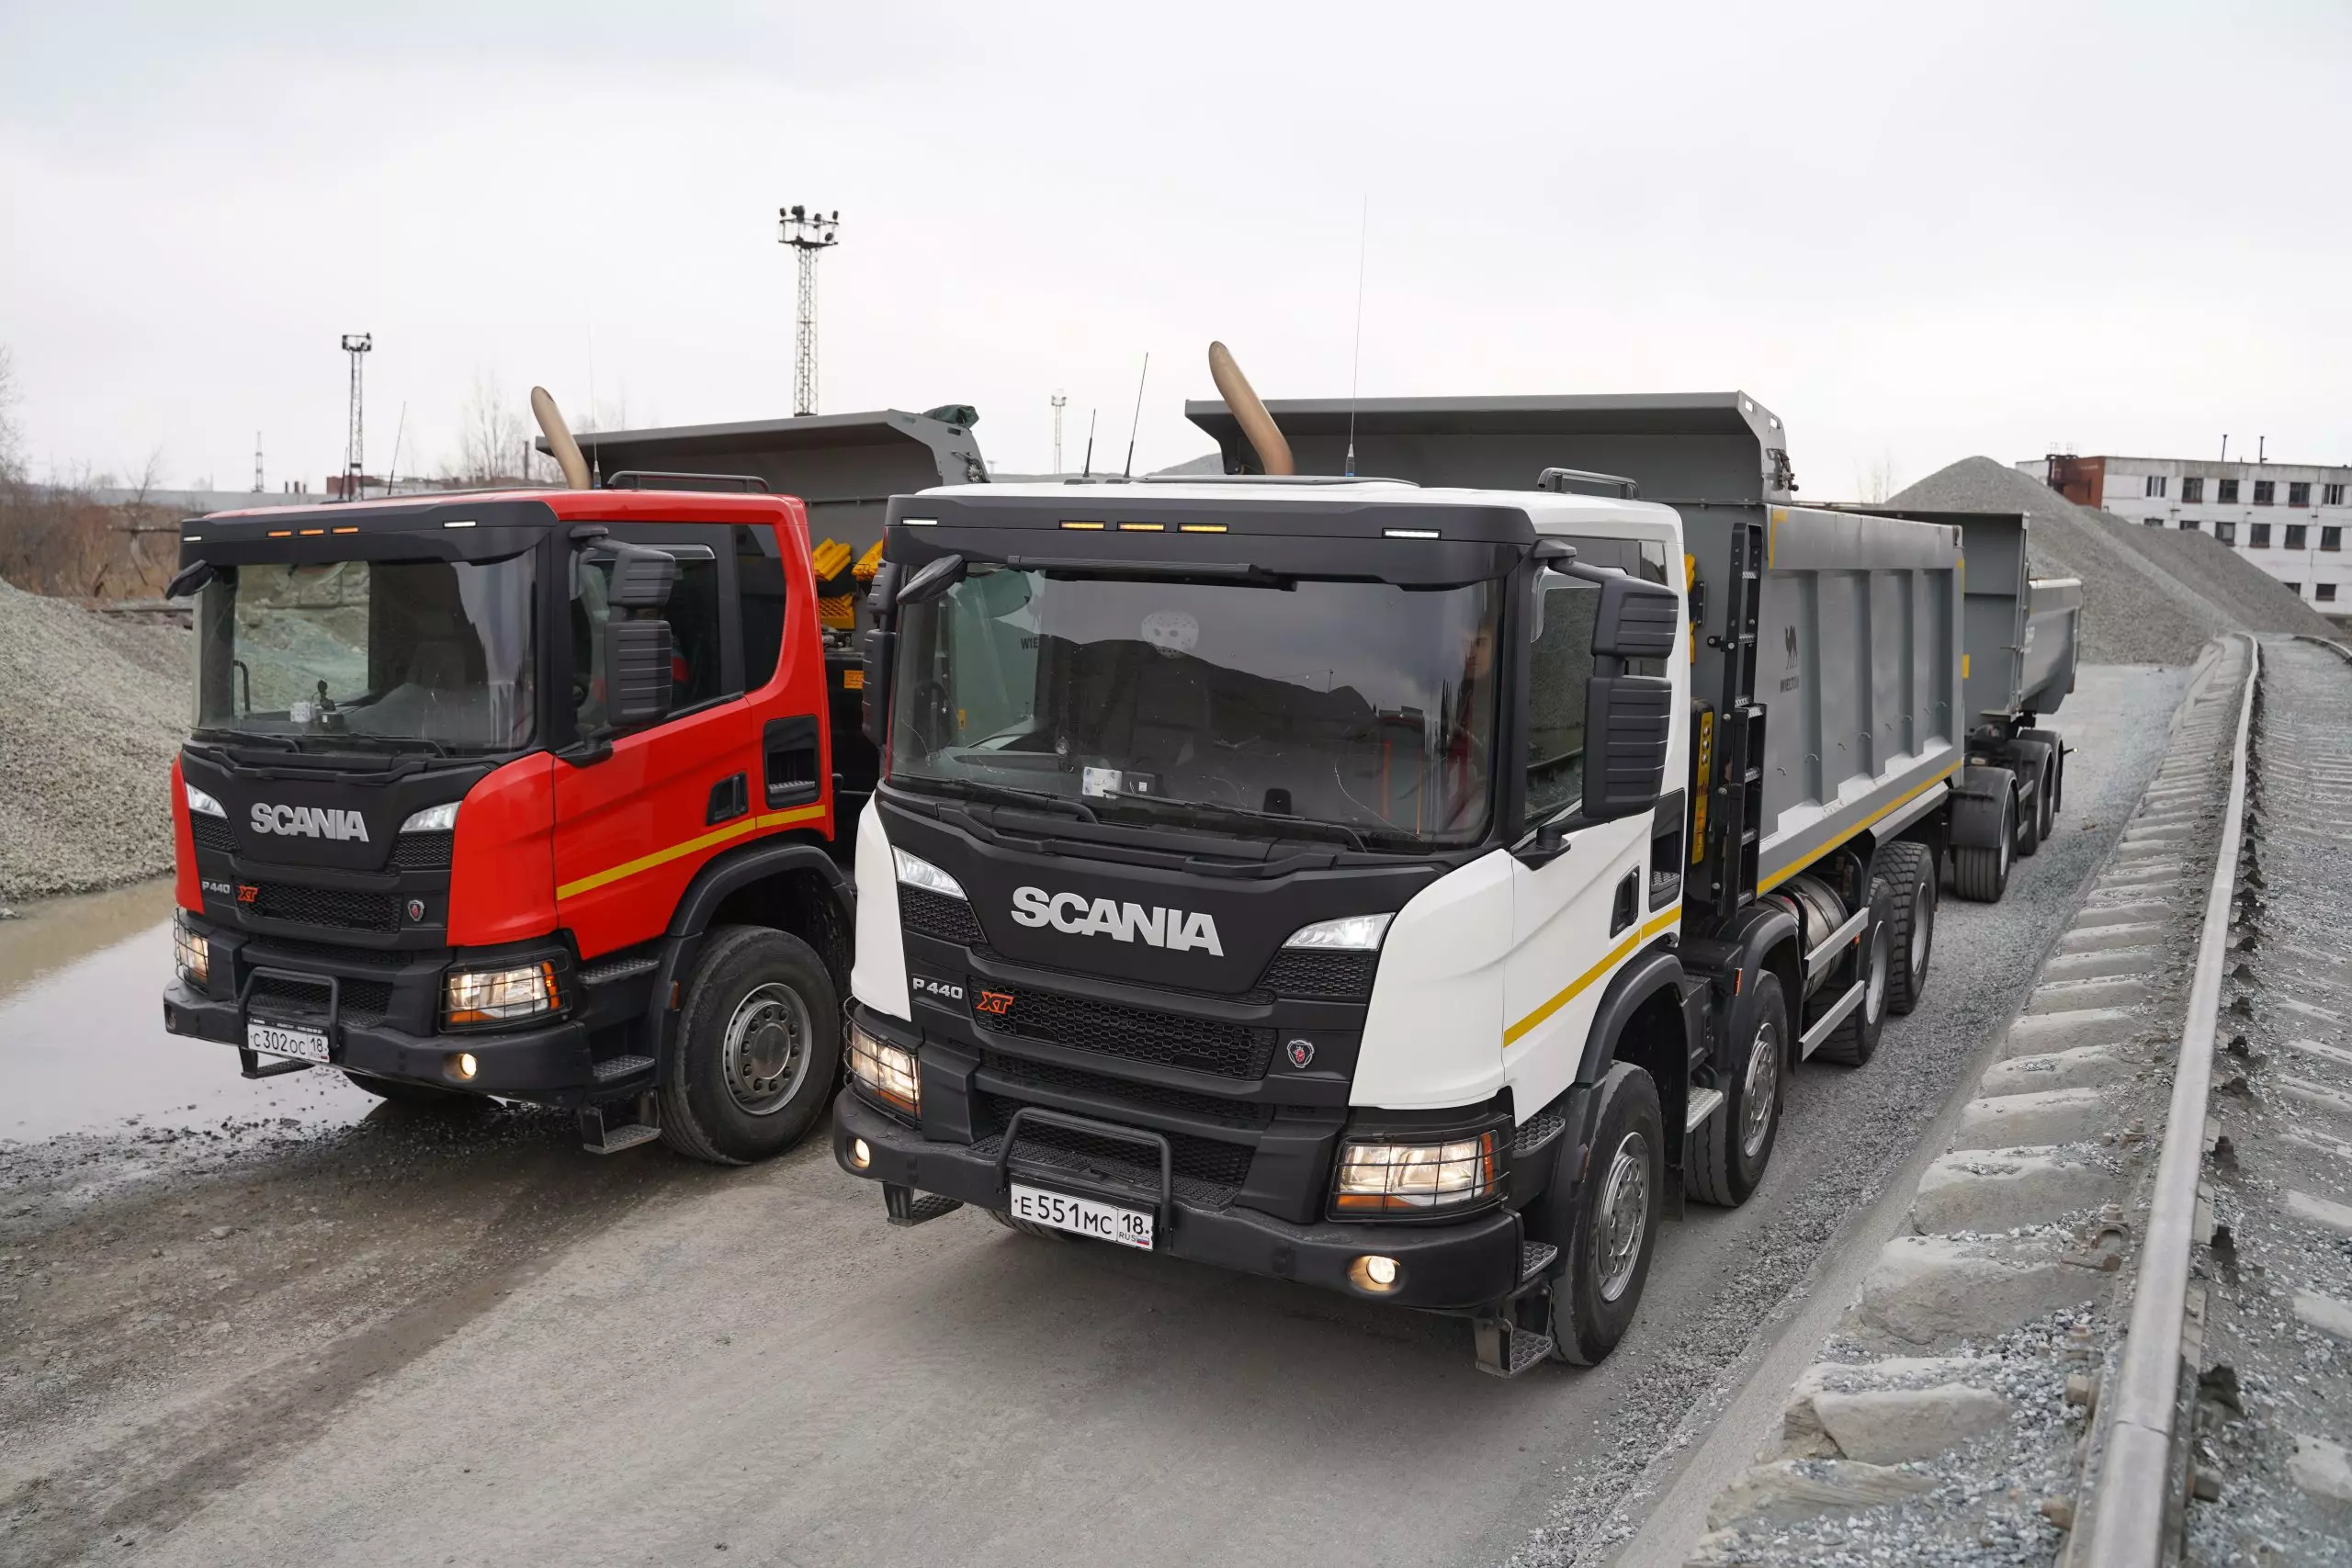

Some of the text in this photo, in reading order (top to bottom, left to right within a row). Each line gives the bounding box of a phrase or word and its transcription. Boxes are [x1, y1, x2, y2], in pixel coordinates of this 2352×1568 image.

[251, 803, 369, 842] SCANIA
[202, 881, 230, 894] P 440
[237, 886, 258, 903] XT
[1011, 886, 1225, 957] SCANIA
[912, 977, 963, 999] P 440
[976, 991, 1014, 1014] XT
[310, 1038, 323, 1053] 18
[1122, 1213, 1144, 1235] 18
[1118, 1231, 1136, 1242] RUS
